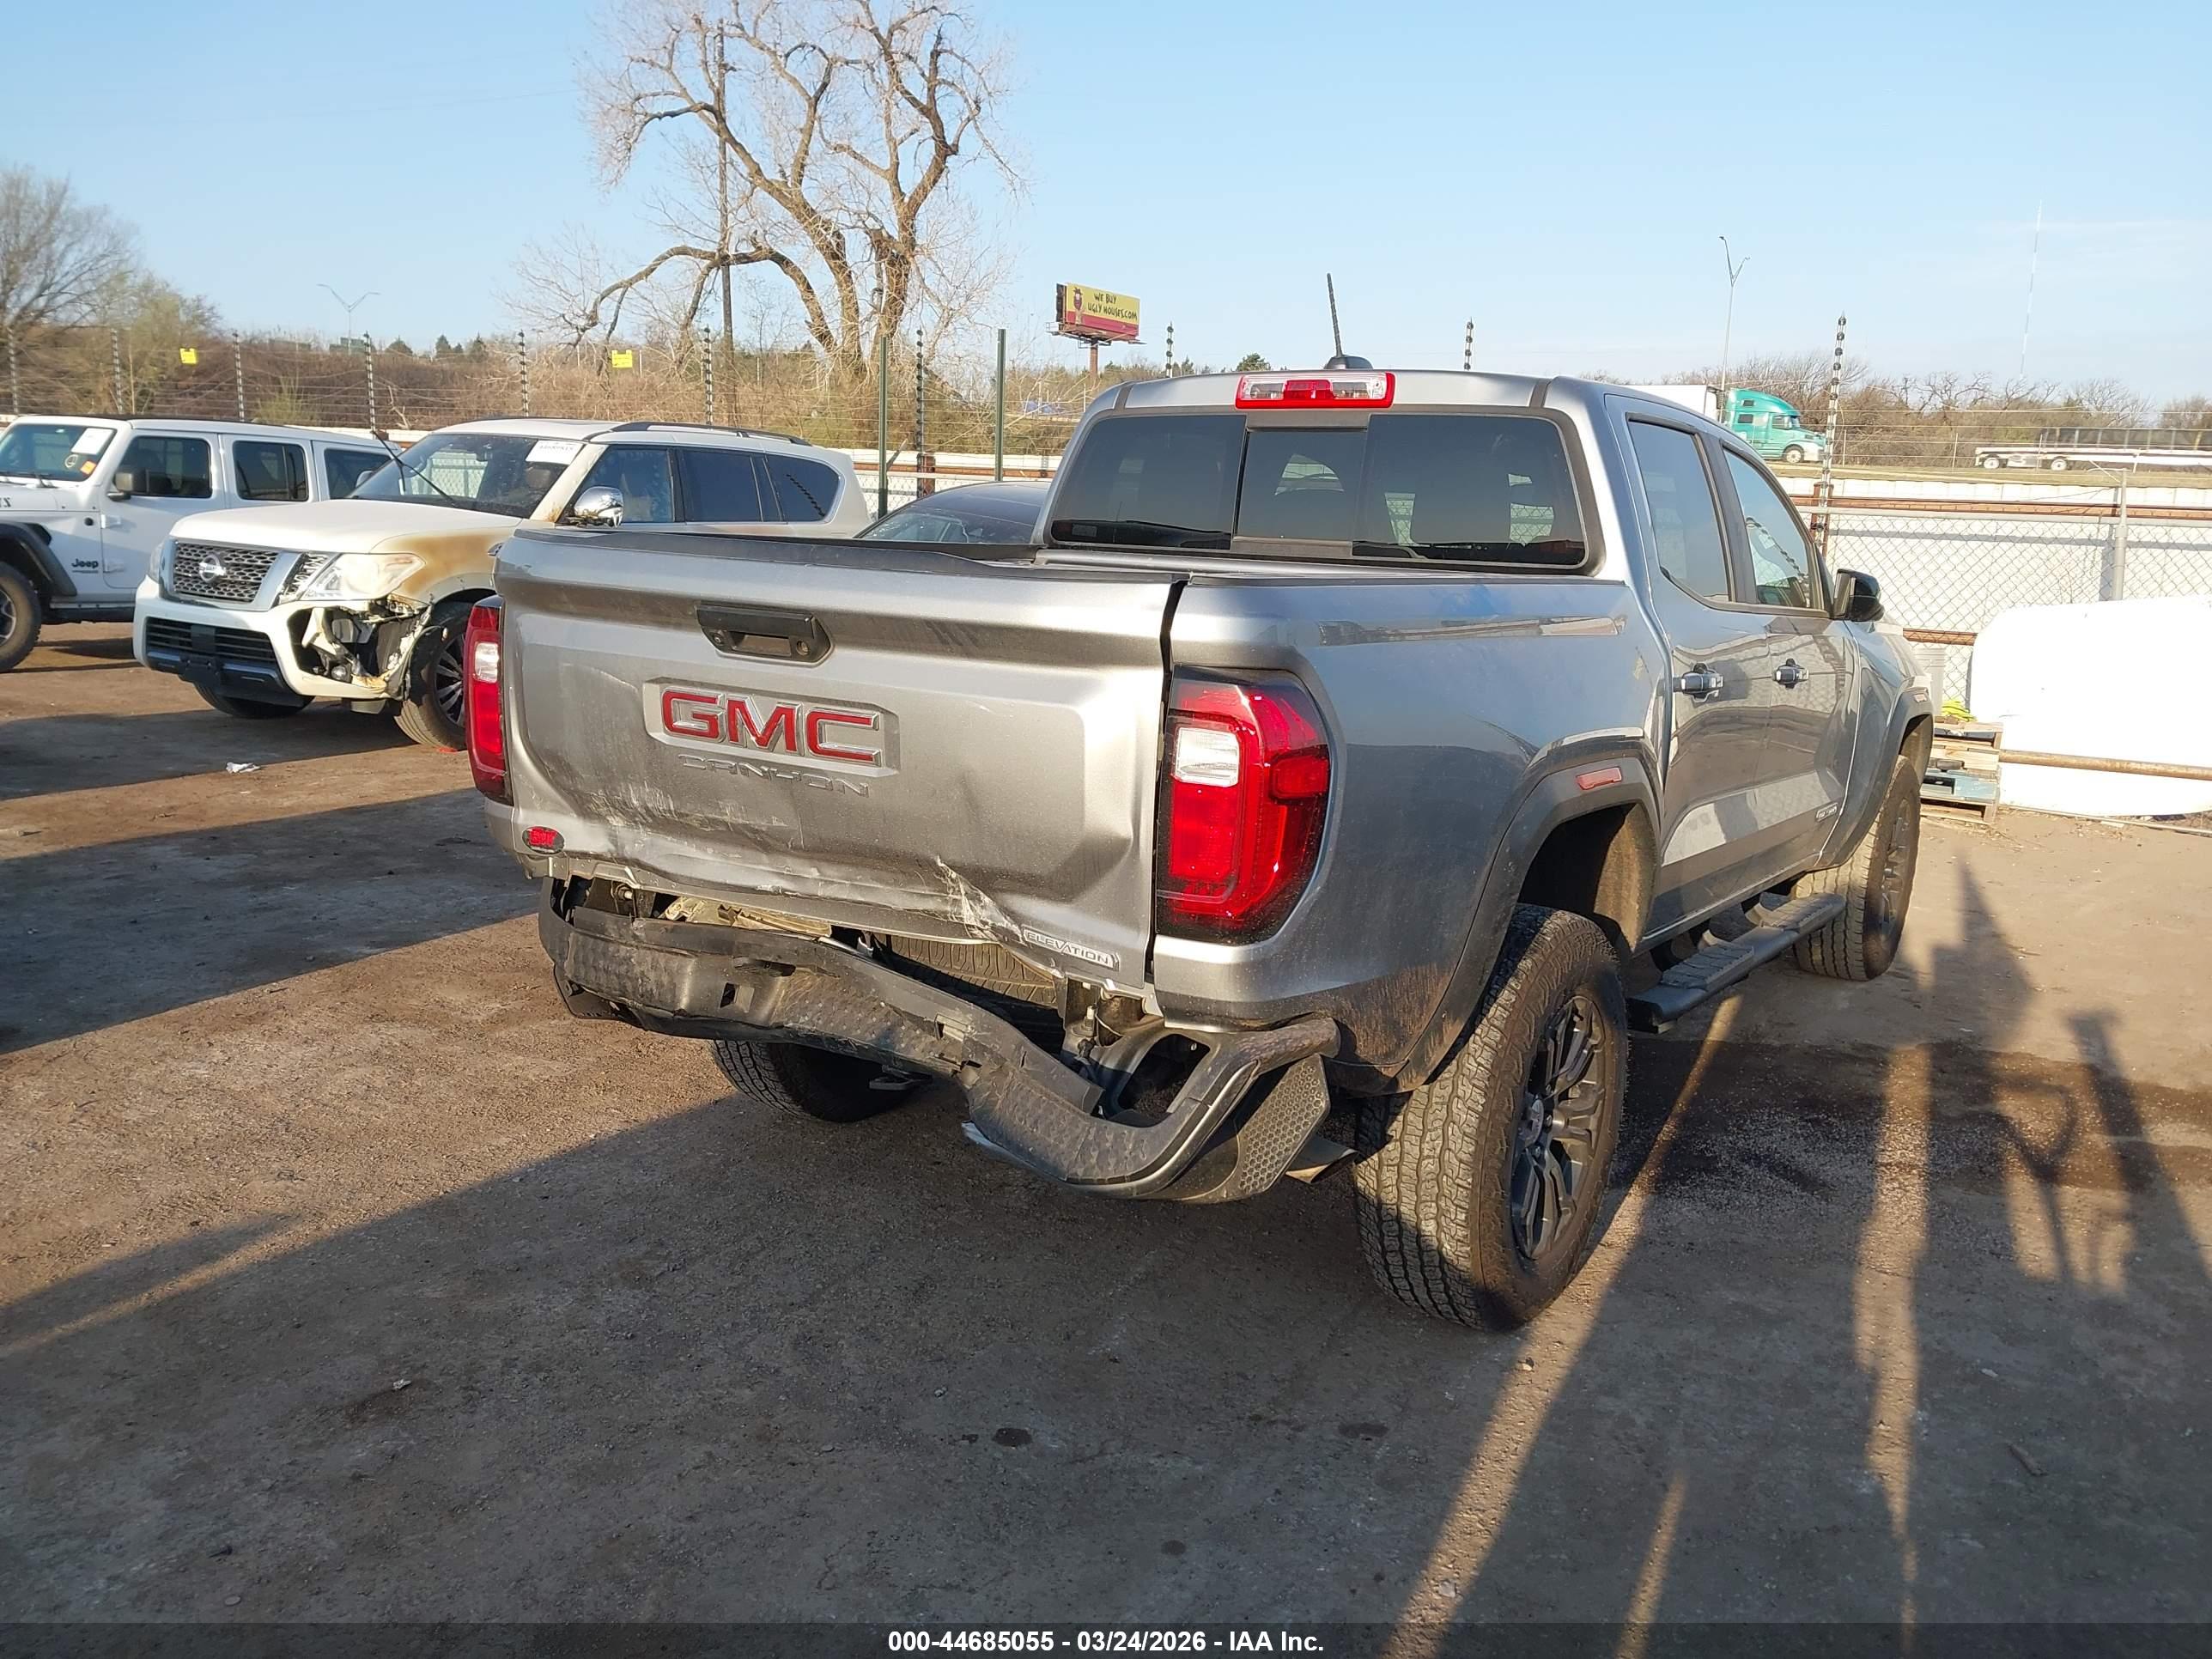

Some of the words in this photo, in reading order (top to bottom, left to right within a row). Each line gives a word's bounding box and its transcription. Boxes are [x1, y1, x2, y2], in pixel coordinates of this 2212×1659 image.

[1094, 293, 1103, 302] WE
[1106, 293, 1117, 304] BUY
[1087, 302, 1102, 313] UGLY
[71, 558, 99, 568] Jeep
[661, 688, 882, 767] GMC
[1028, 932, 1109, 965] ELEVATION
